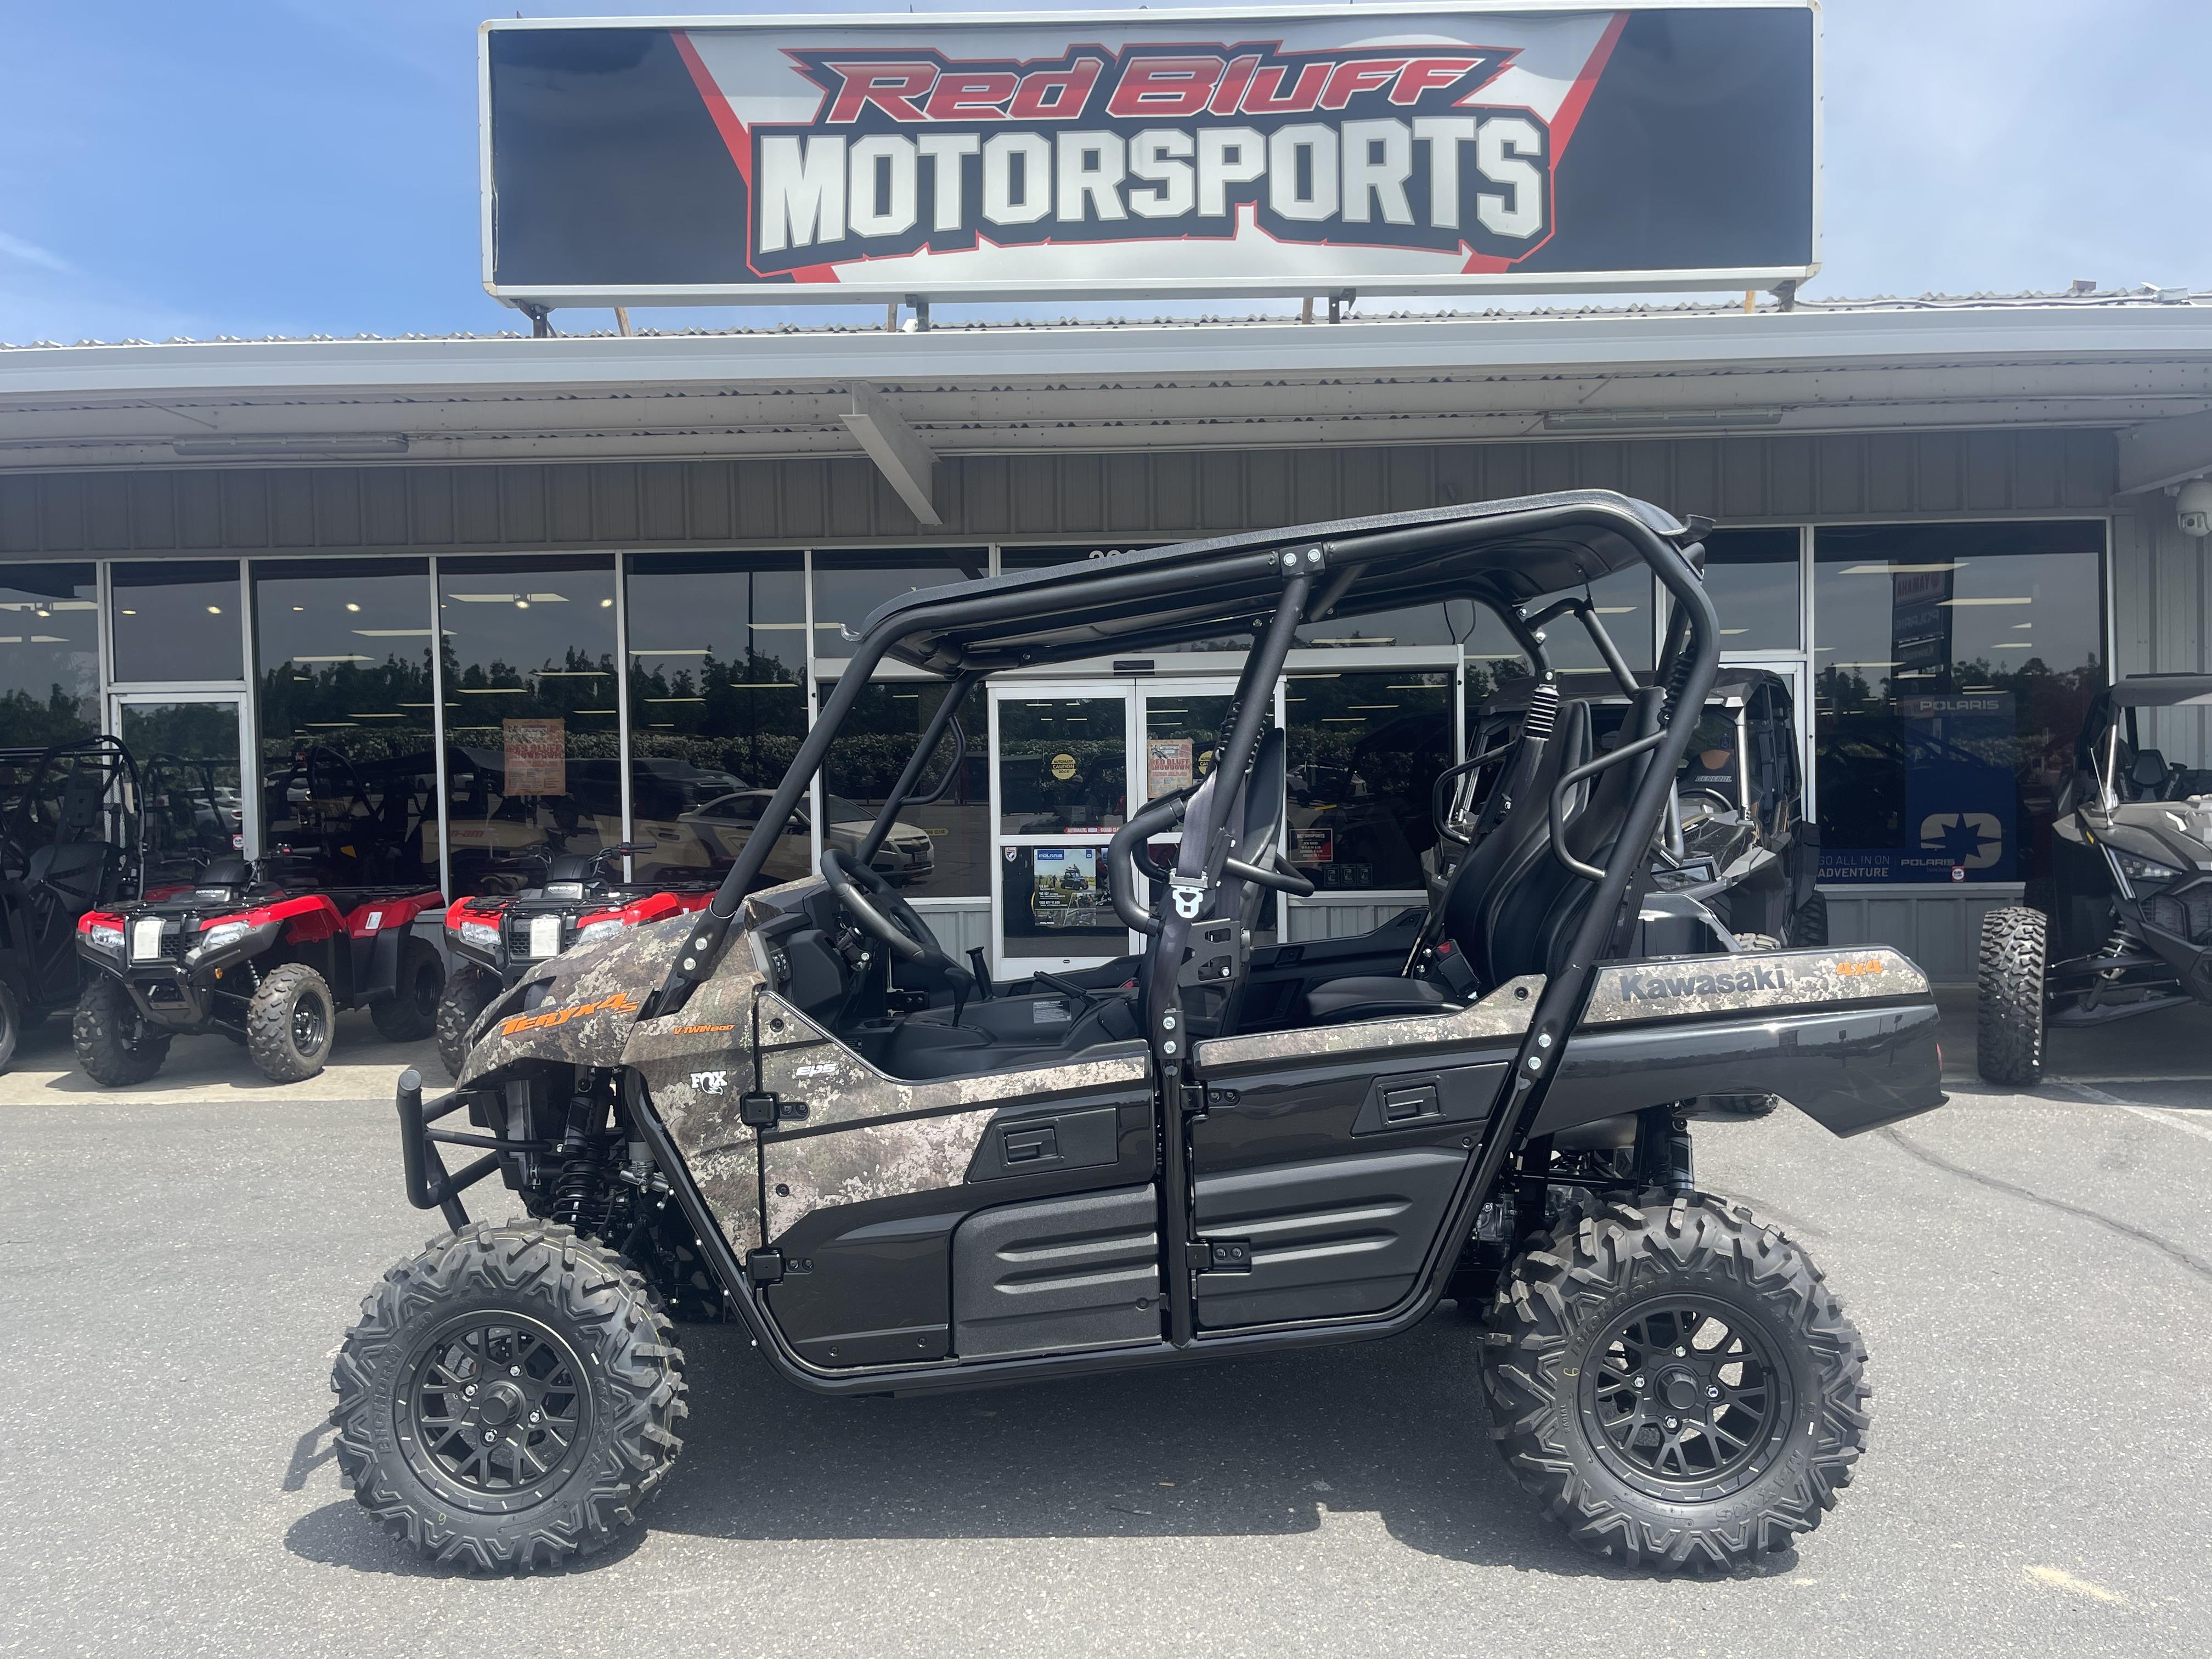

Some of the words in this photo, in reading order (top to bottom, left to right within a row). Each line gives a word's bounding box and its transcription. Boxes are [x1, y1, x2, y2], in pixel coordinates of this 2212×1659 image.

[759, 116, 1543, 254] MOTORSPORTS
[1920, 700, 1999, 711] POLARIS
[1818, 867, 1889, 878] ADVENTURE
[1836, 856, 1858, 865] ALL
[1861, 855, 1872, 865] IN
[1875, 855, 1889, 865] ON
[1620, 963, 1786, 1001] Kawasaki
[1835, 959, 1883, 977] 4x4
[690, 1070, 728, 1096] FOX
[373, 1344, 404, 1453] BIGHORN
[1560, 1404, 1571, 1434] RADIAL
[1716, 1449, 1805, 1523] MAXXIS
